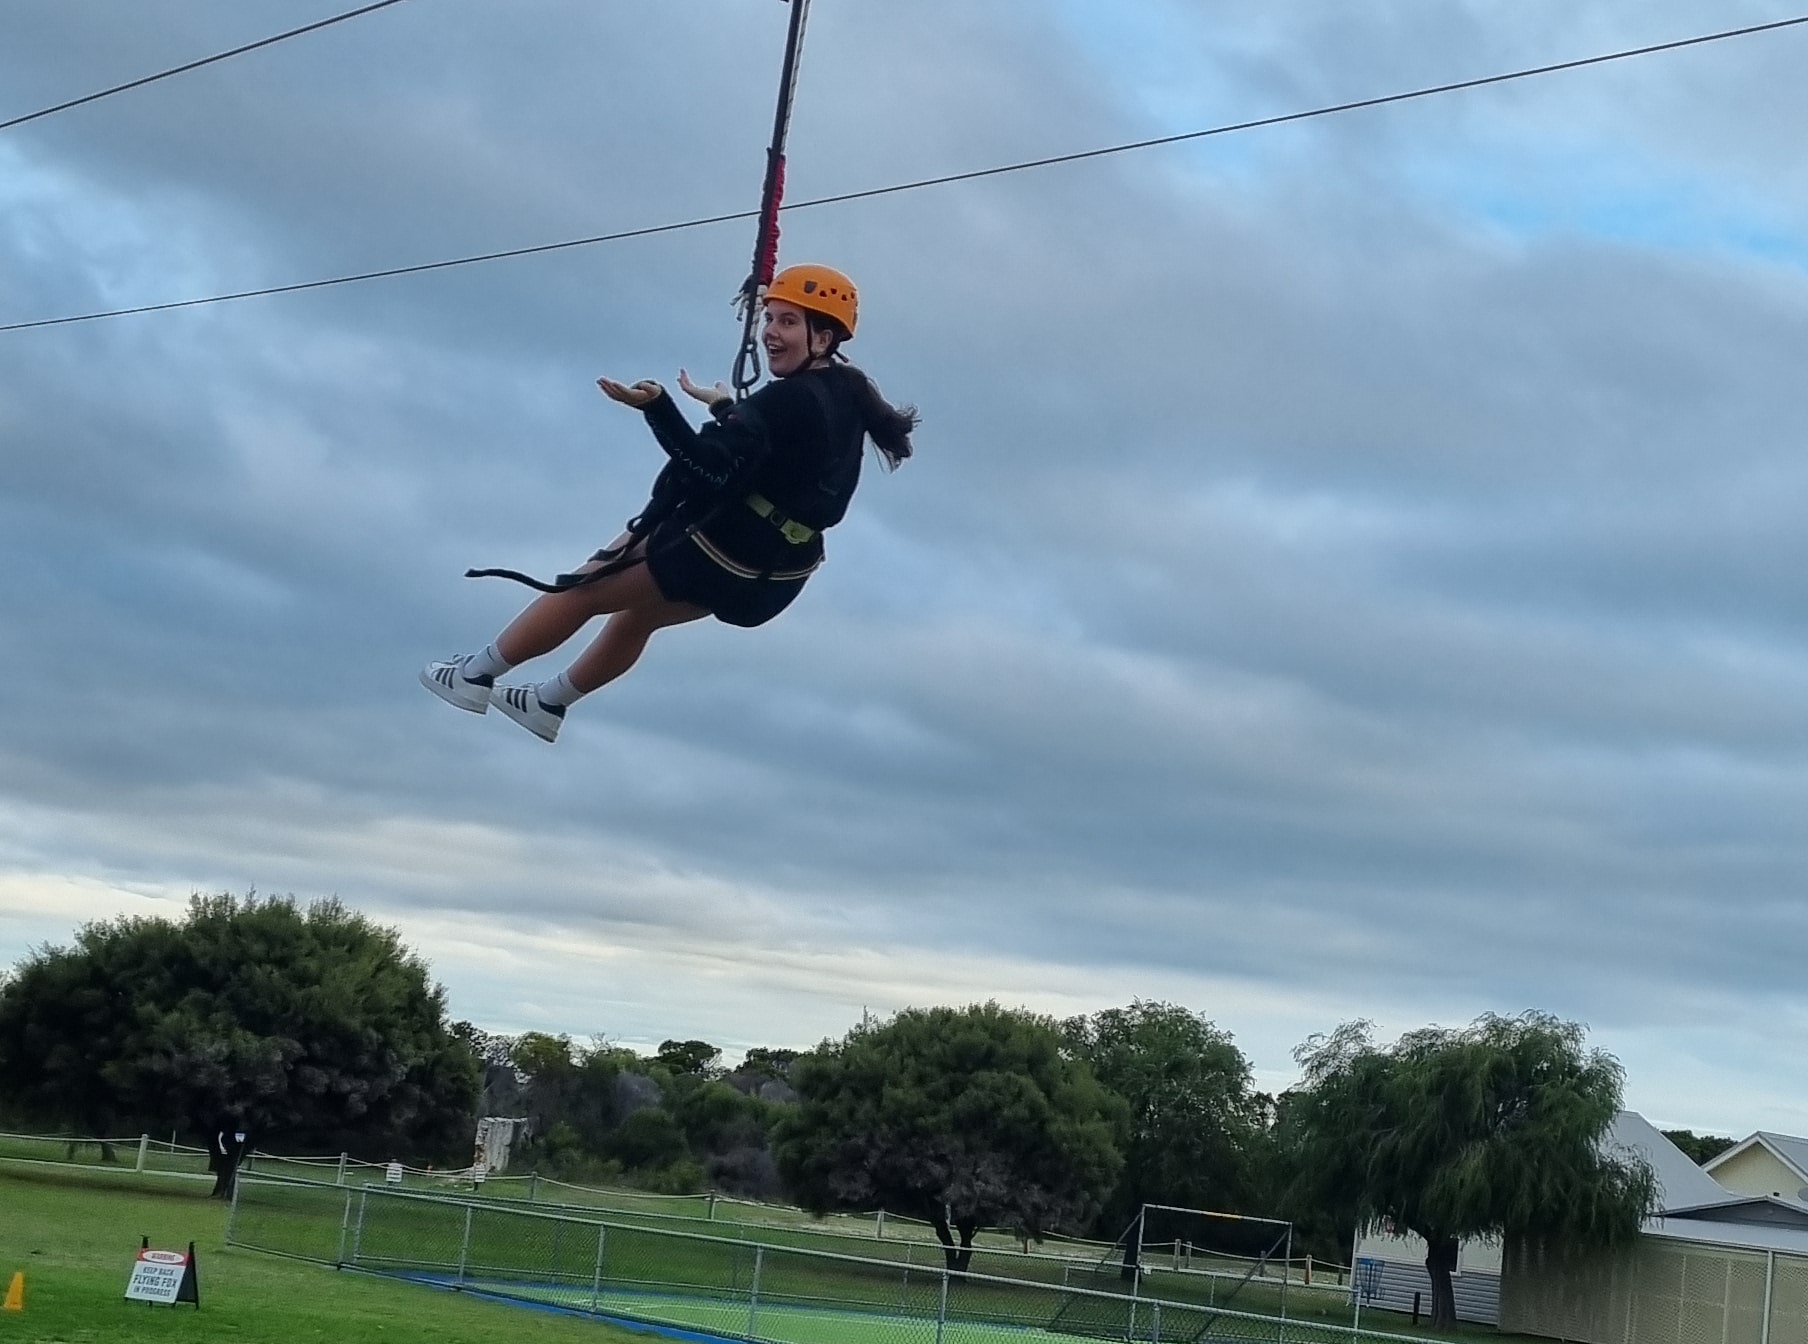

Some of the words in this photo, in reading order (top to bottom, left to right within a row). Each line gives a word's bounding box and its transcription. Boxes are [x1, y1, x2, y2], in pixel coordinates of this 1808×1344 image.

[158, 1268, 175, 1276] BACK
[132, 1274, 161, 1286] FLYING
[161, 1277, 178, 1288] FOX
[141, 1286, 171, 1297] PROGRESS
